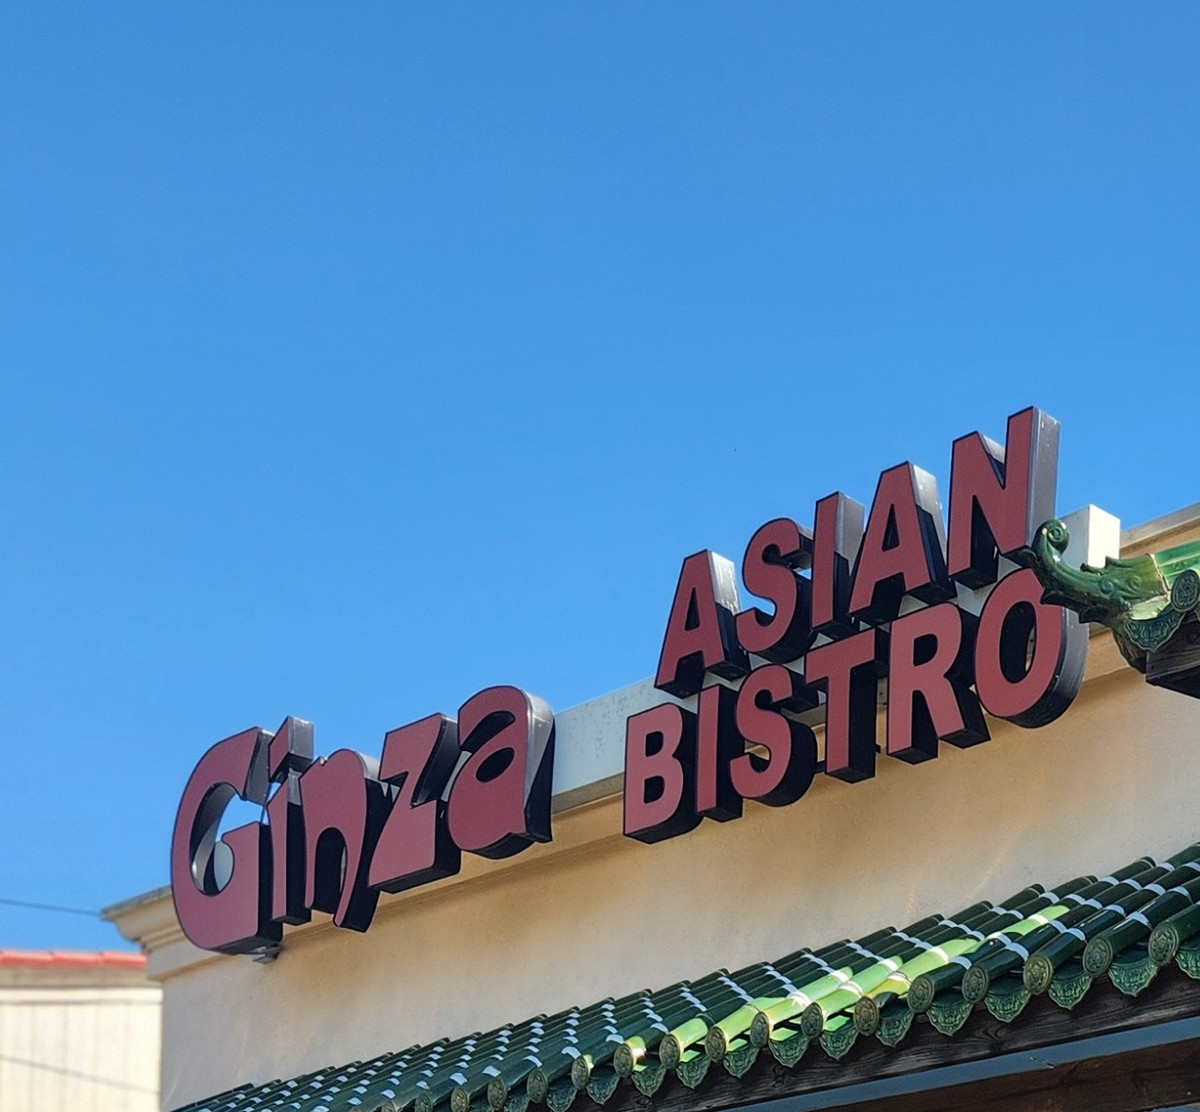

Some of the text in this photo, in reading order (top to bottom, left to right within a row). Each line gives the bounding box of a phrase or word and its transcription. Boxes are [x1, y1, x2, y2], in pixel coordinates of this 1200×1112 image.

[654, 405, 1054, 697] ASIAN
[170, 685, 552, 954] Ginza
[622, 566, 1076, 844] BISTRO
